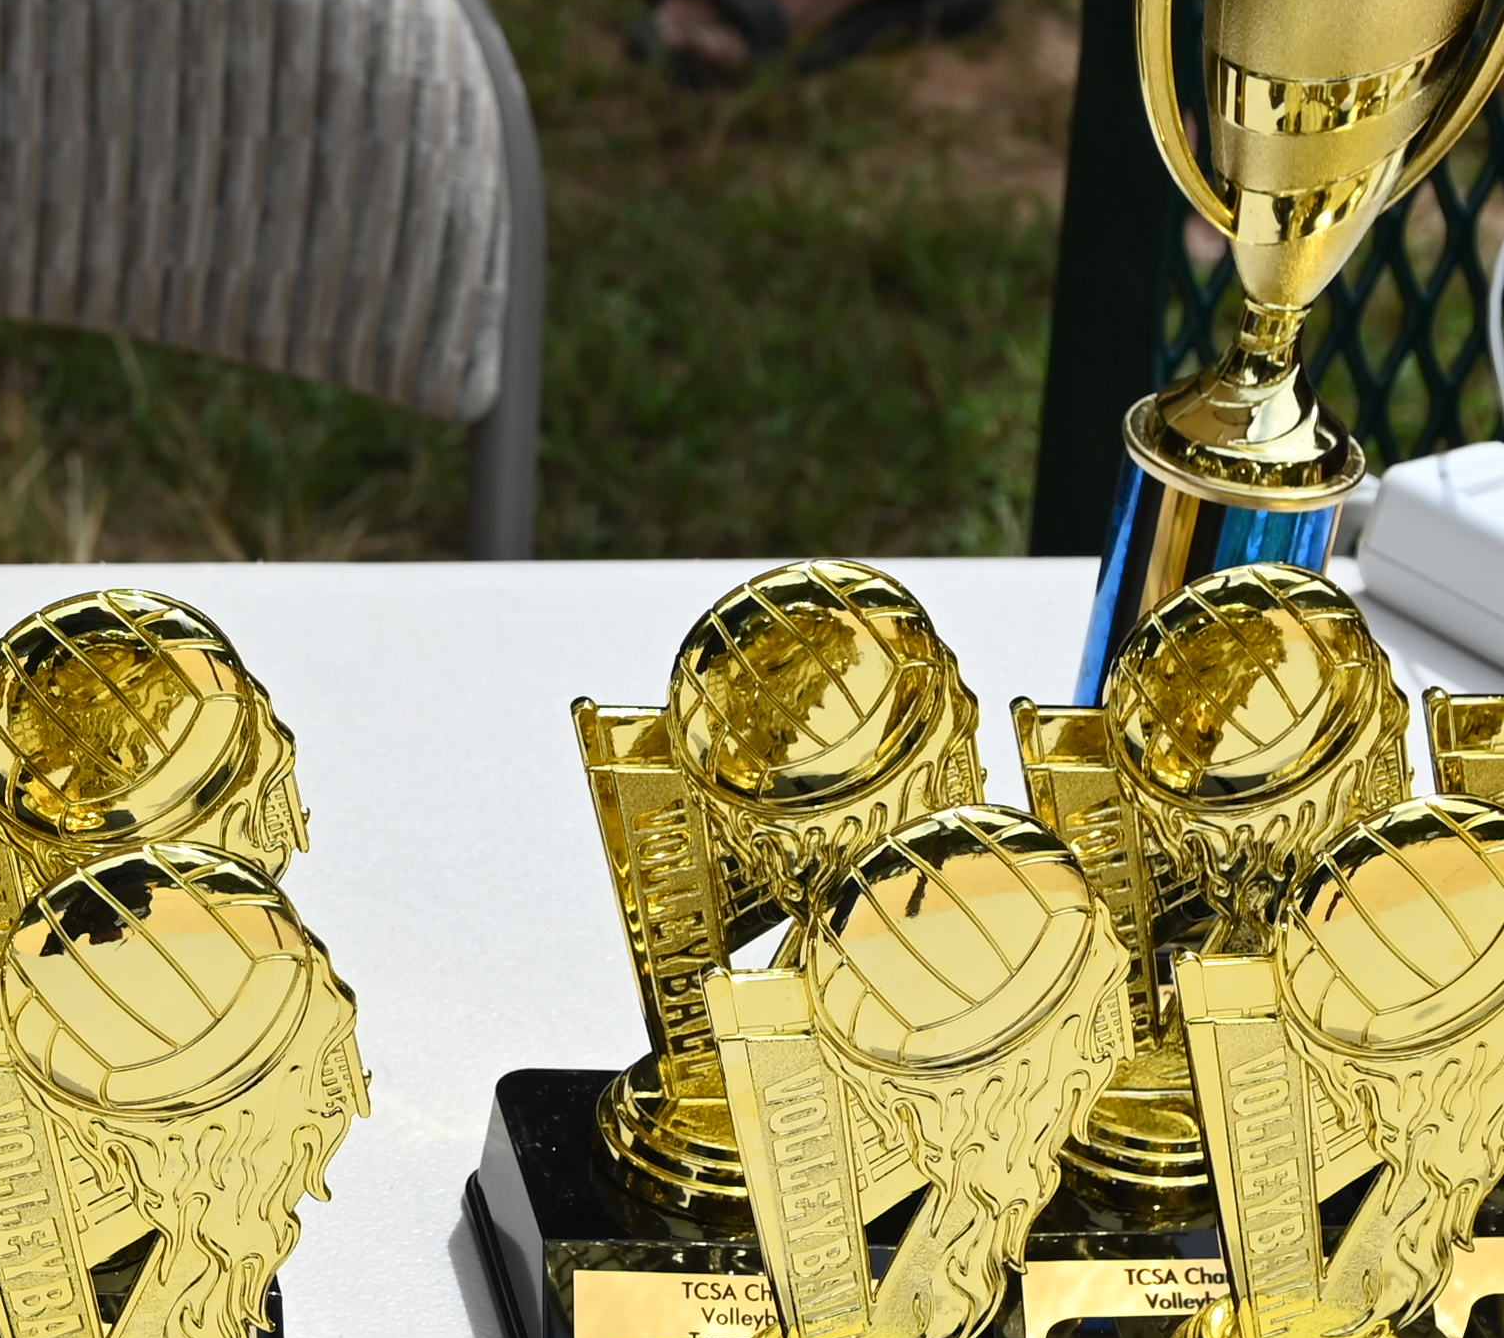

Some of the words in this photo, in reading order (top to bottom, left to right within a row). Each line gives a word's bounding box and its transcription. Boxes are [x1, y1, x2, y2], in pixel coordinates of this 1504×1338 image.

[1124, 1268, 1179, 1285] TCSA
[681, 1282, 737, 1301] TCSA
[701, 1306, 777, 1331] Volleyb
